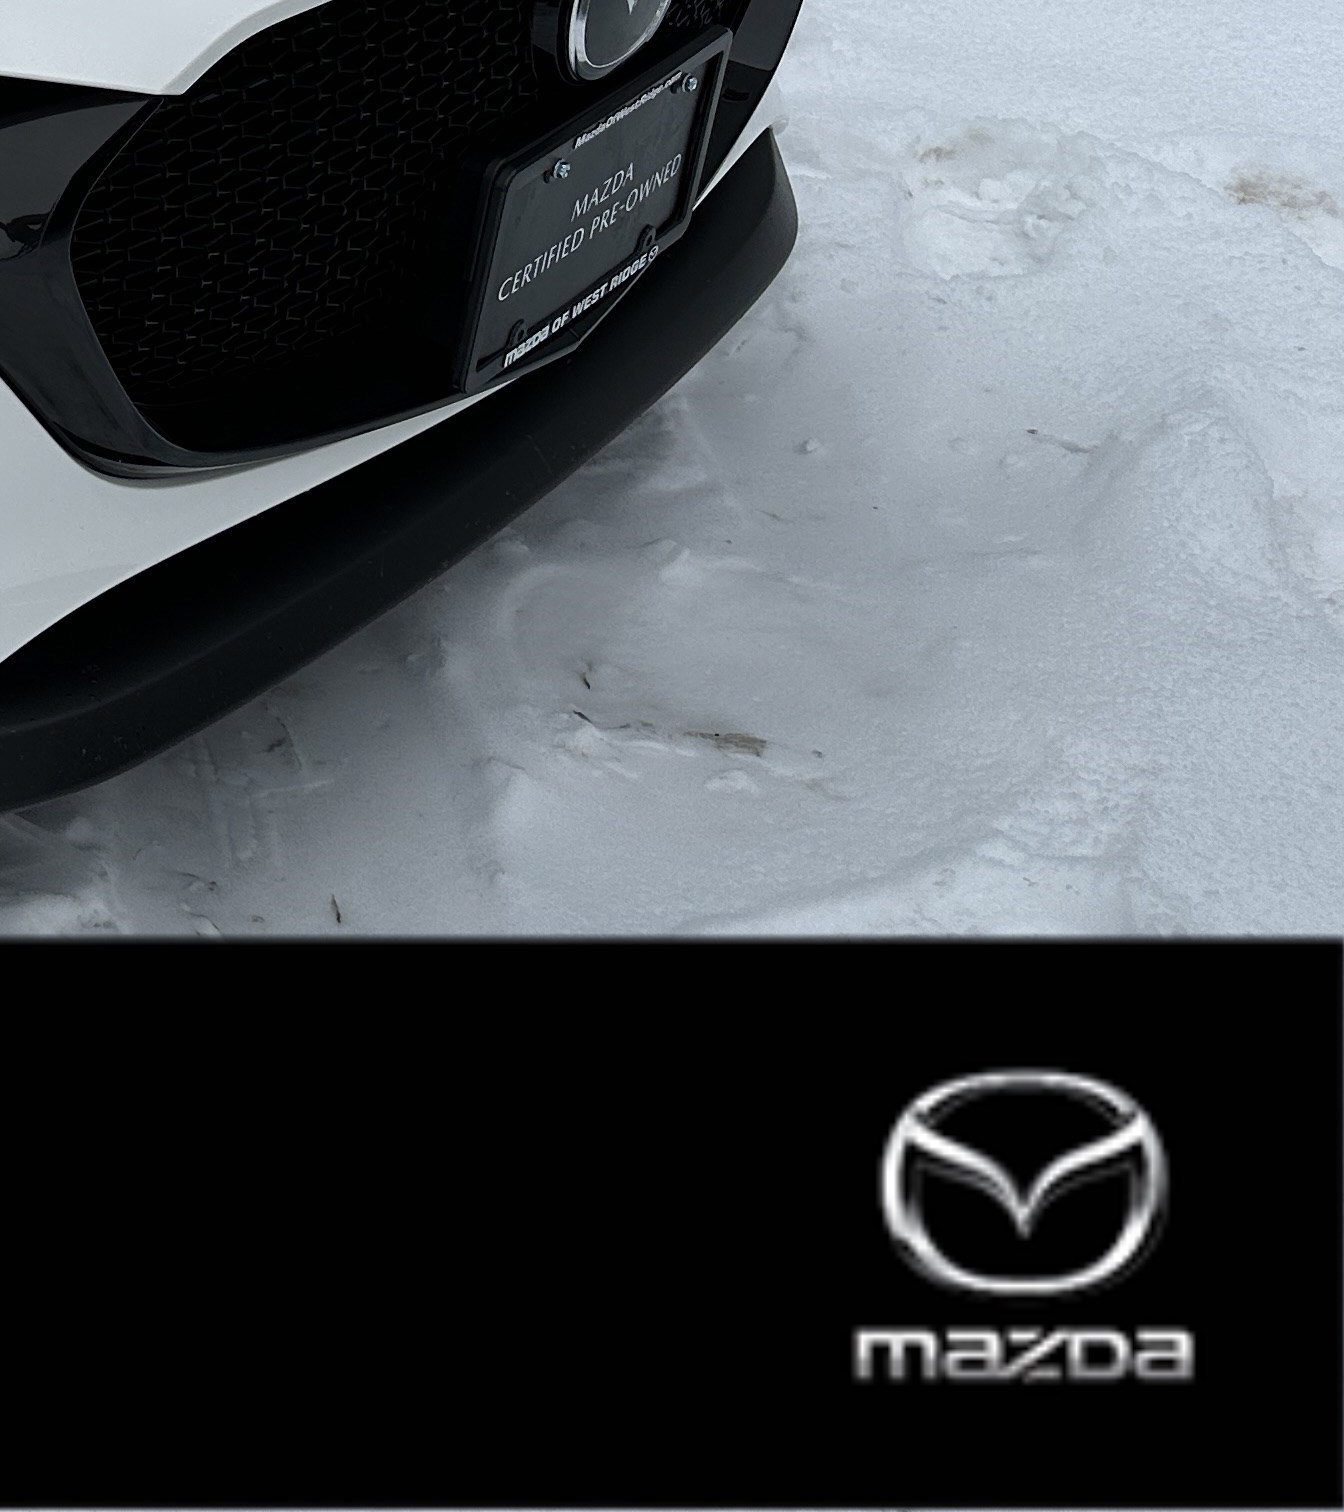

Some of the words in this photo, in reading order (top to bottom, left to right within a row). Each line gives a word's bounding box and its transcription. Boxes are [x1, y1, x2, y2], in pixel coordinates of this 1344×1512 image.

[498, 227, 585, 301] CERTIFIED
[589, 153, 682, 239] PRE-OWNED
[570, 162, 634, 222] MAZDA
[551, 310, 570, 334] OF
[571, 283, 608, 319] WEST
[609, 252, 648, 291] RIDGE
